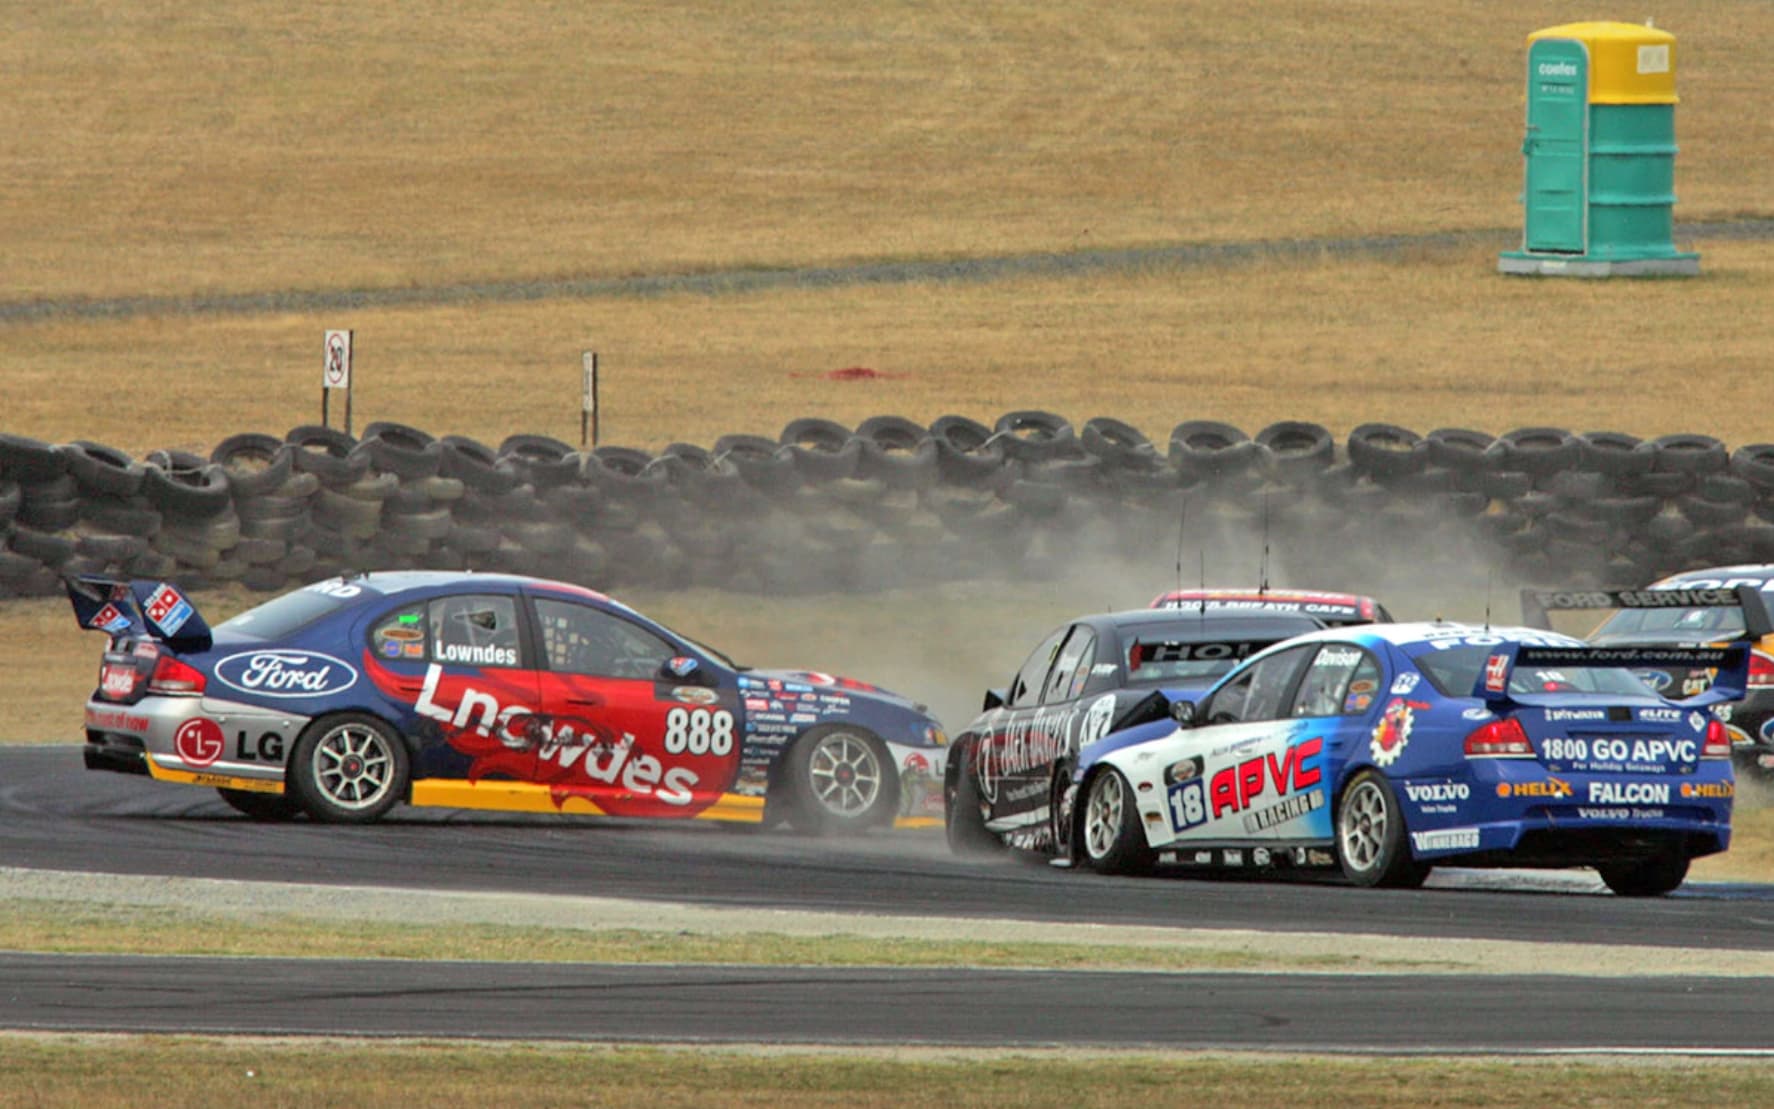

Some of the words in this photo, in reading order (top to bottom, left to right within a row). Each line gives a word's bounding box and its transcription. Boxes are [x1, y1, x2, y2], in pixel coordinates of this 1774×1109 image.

[1536, 591, 1612, 608] FORD
[1618, 590, 1740, 606] SERVICE
[436, 640, 517, 664] Lowndes
[1527, 649, 1725, 660] www.ford.com.au
[242, 653, 331, 691] Ford
[665, 707, 734, 755] 888
[237, 730, 284, 762] LG
[1541, 739, 1587, 760] 1800
[1591, 739, 1629, 760] GO
[1631, 740, 1697, 762] APVC
[1211, 737, 1323, 819] APVC
[1513, 778, 1574, 797] HELIX
[1405, 783, 1470, 802] VOLVO
[1589, 783, 1669, 804] FALCON
[1170, 786, 1205, 828] 18
[1258, 794, 1312, 829] RACING
[1577, 807, 1630, 818] VOLVO
